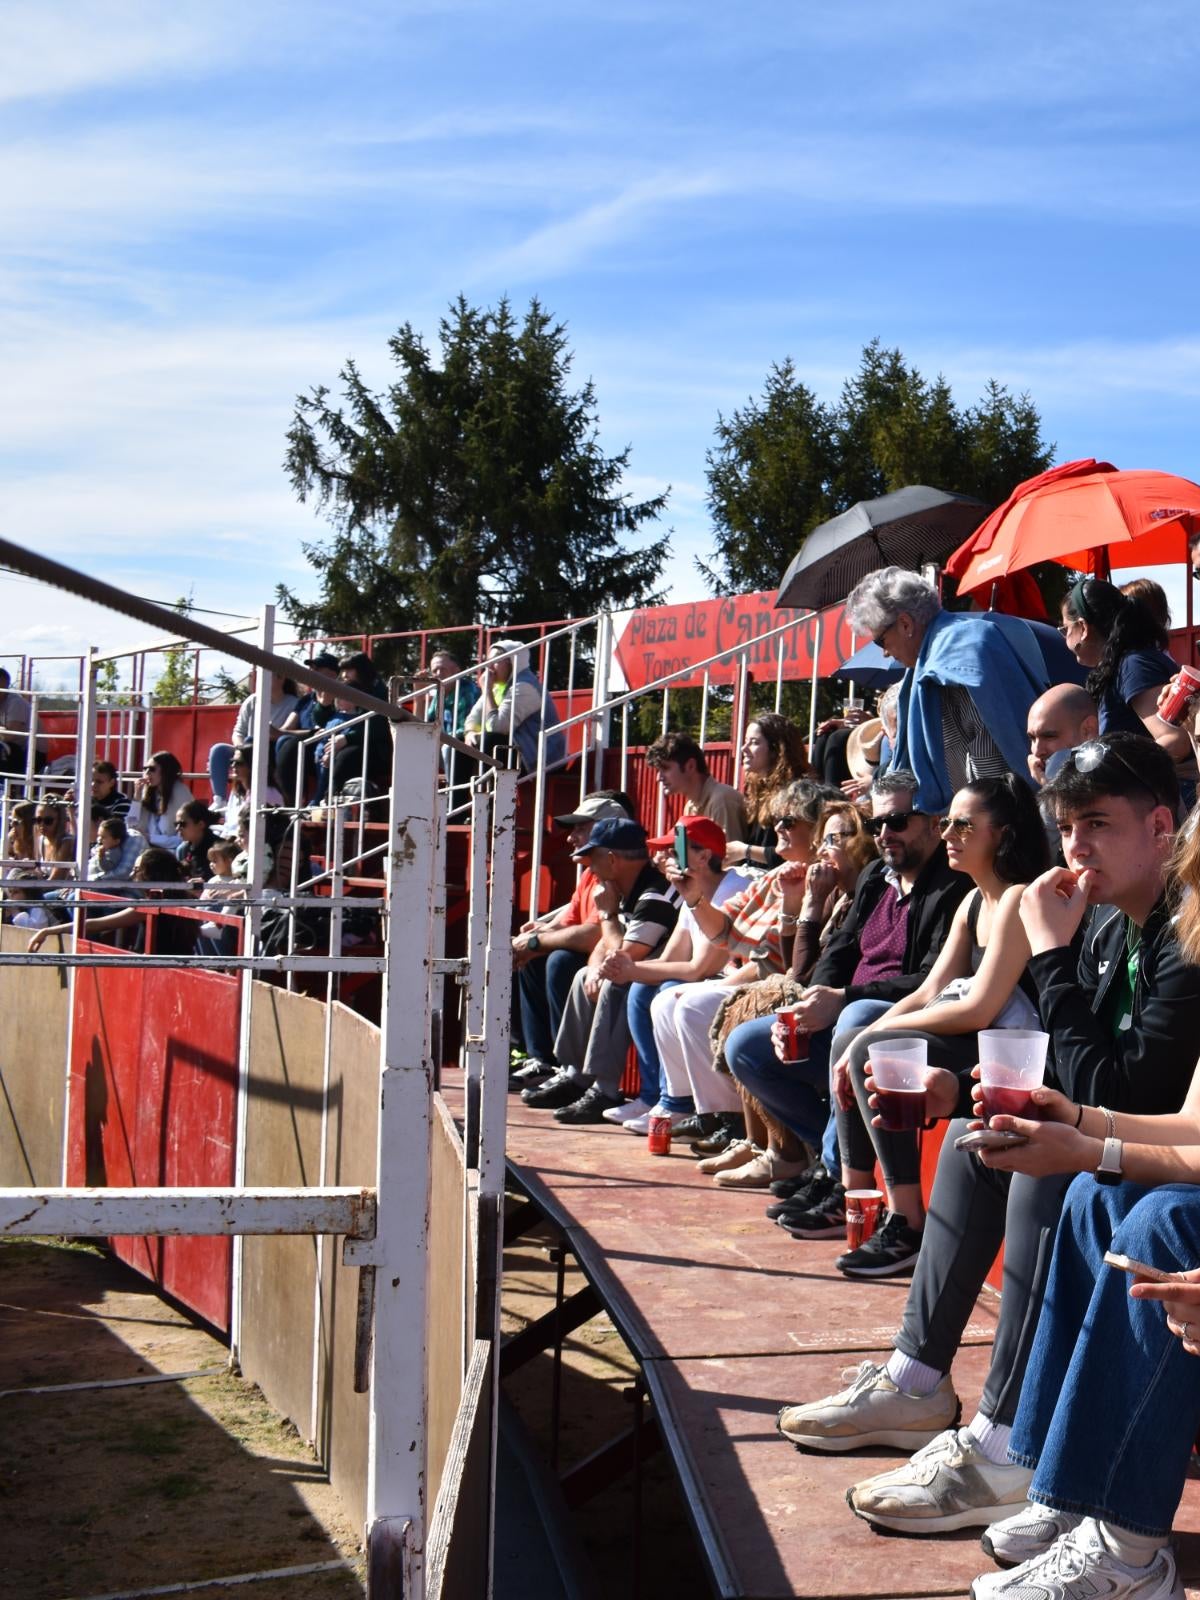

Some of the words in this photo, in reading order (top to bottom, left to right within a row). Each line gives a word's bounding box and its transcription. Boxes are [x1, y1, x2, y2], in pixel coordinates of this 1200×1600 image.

[630, 614, 677, 646] Plaza
[685, 604, 706, 639] de
[716, 596, 825, 666] Cañero
[643, 651, 692, 685] Toros
